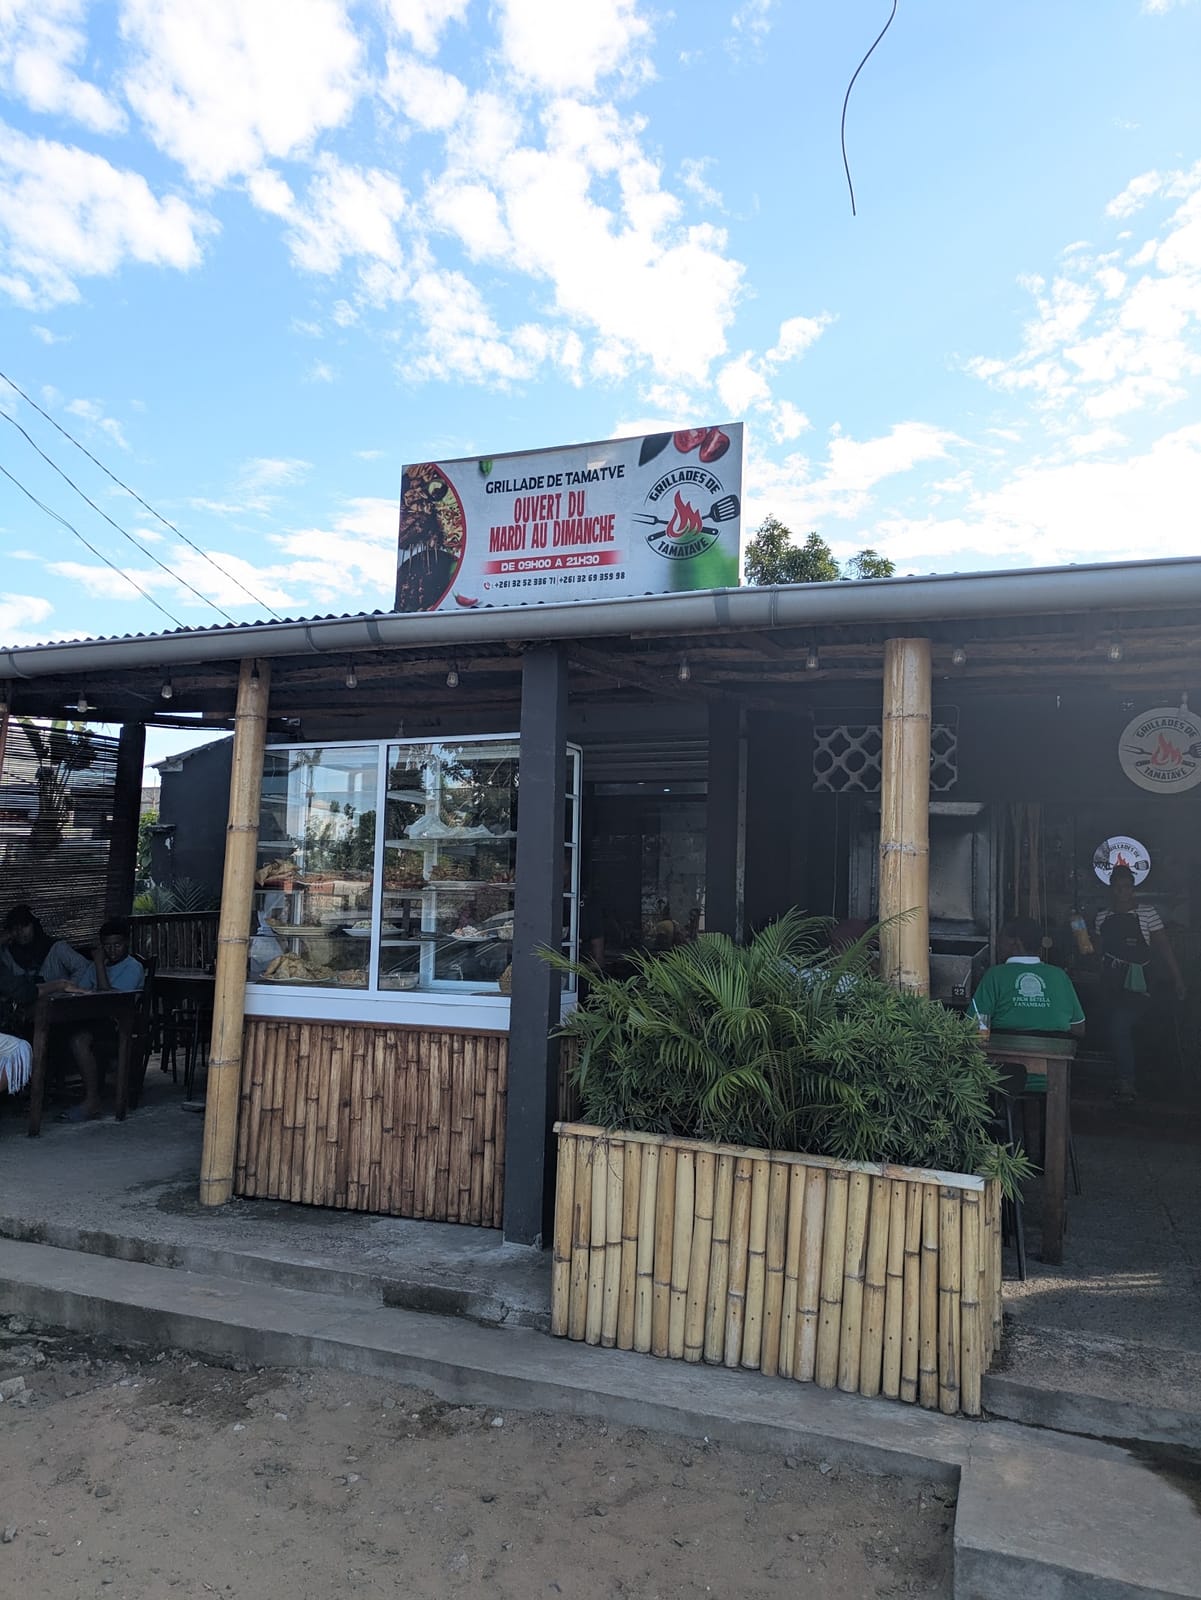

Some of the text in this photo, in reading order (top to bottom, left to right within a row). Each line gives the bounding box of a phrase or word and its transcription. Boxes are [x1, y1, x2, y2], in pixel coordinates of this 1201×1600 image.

[486, 464, 625, 494] GRILLADE DE TAMATVE
[649, 470, 720, 501] GRILLADES DE
[514, 490, 585, 523] OUVERT DU
[489, 514, 616, 552] MARDI AU DIMANCHE
[657, 537, 709, 557] TAMATAVE
[501, 555, 600, 572] DE 09H00 A 21H30
[1136, 719, 1198, 738] GRILLADES DE
